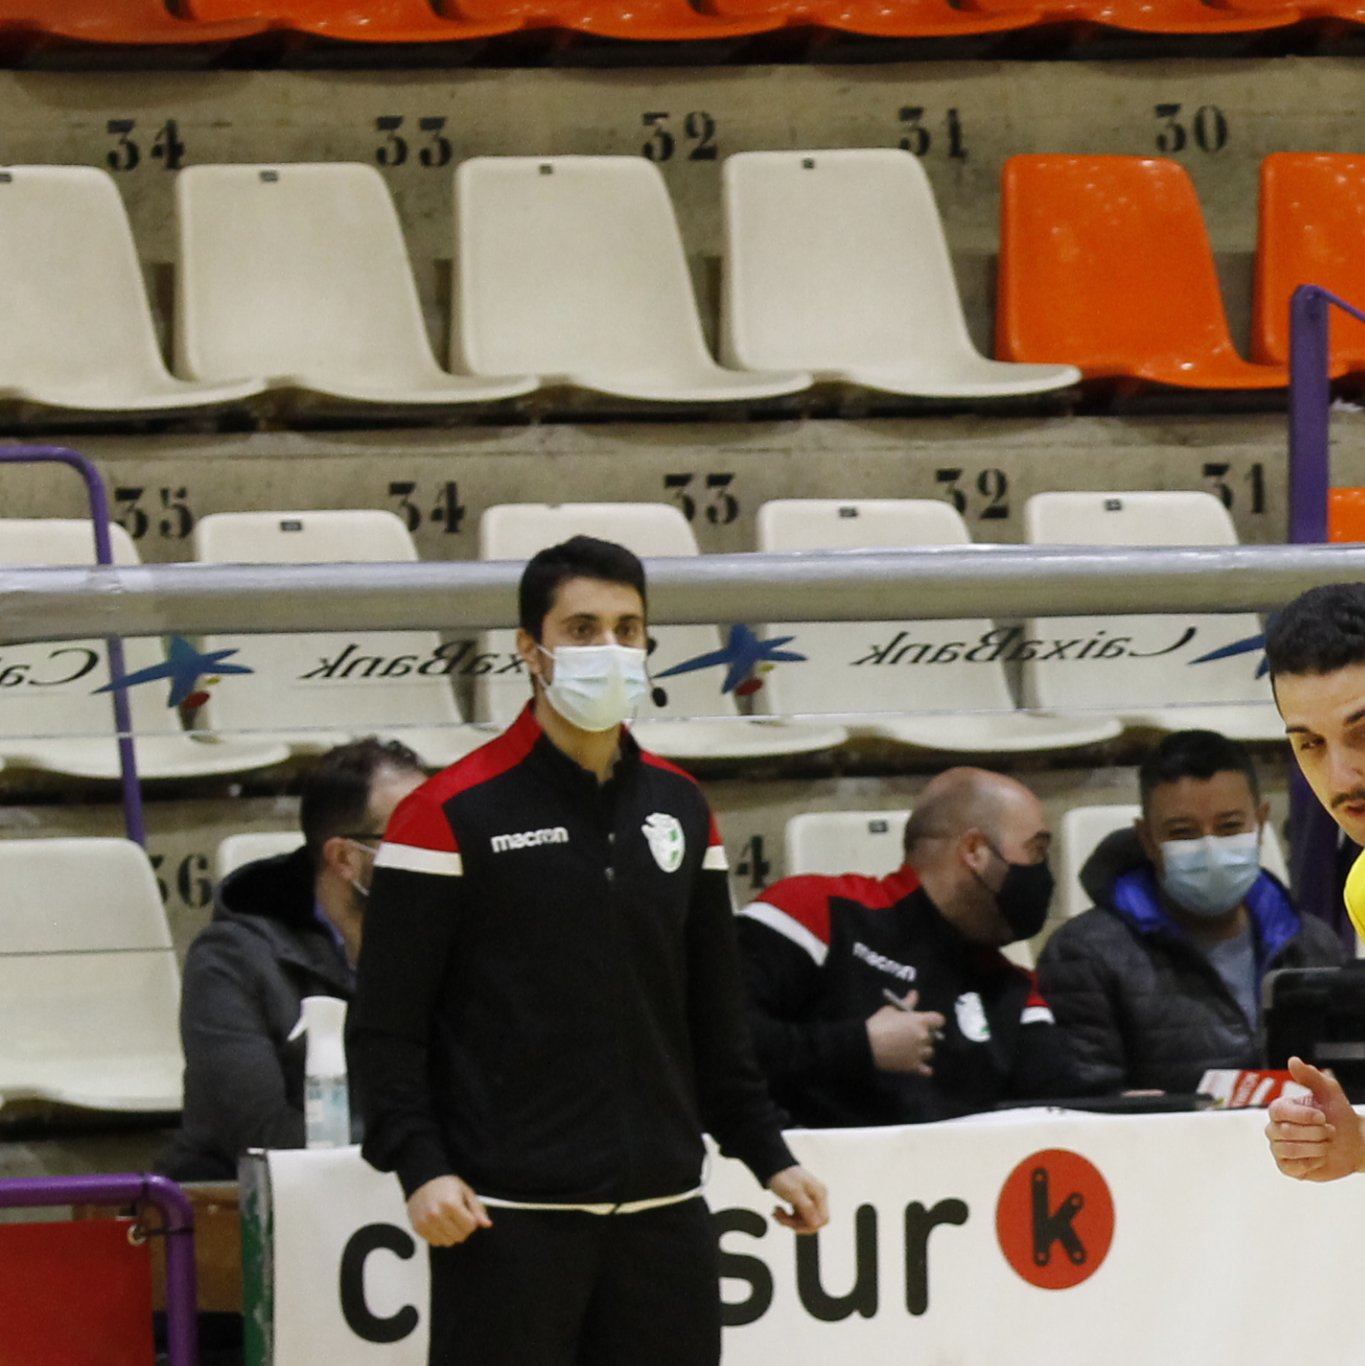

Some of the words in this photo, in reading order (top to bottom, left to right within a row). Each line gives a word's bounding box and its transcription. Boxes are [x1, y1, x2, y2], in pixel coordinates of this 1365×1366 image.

[105, 118, 186, 172] 34
[375, 115, 454, 169] 33
[641, 112, 719, 163] 32
[898, 106, 969, 163] 31
[1154, 103, 1229, 154] 30
[114, 486, 194, 541] 35
[490, 826, 570, 854] macron
